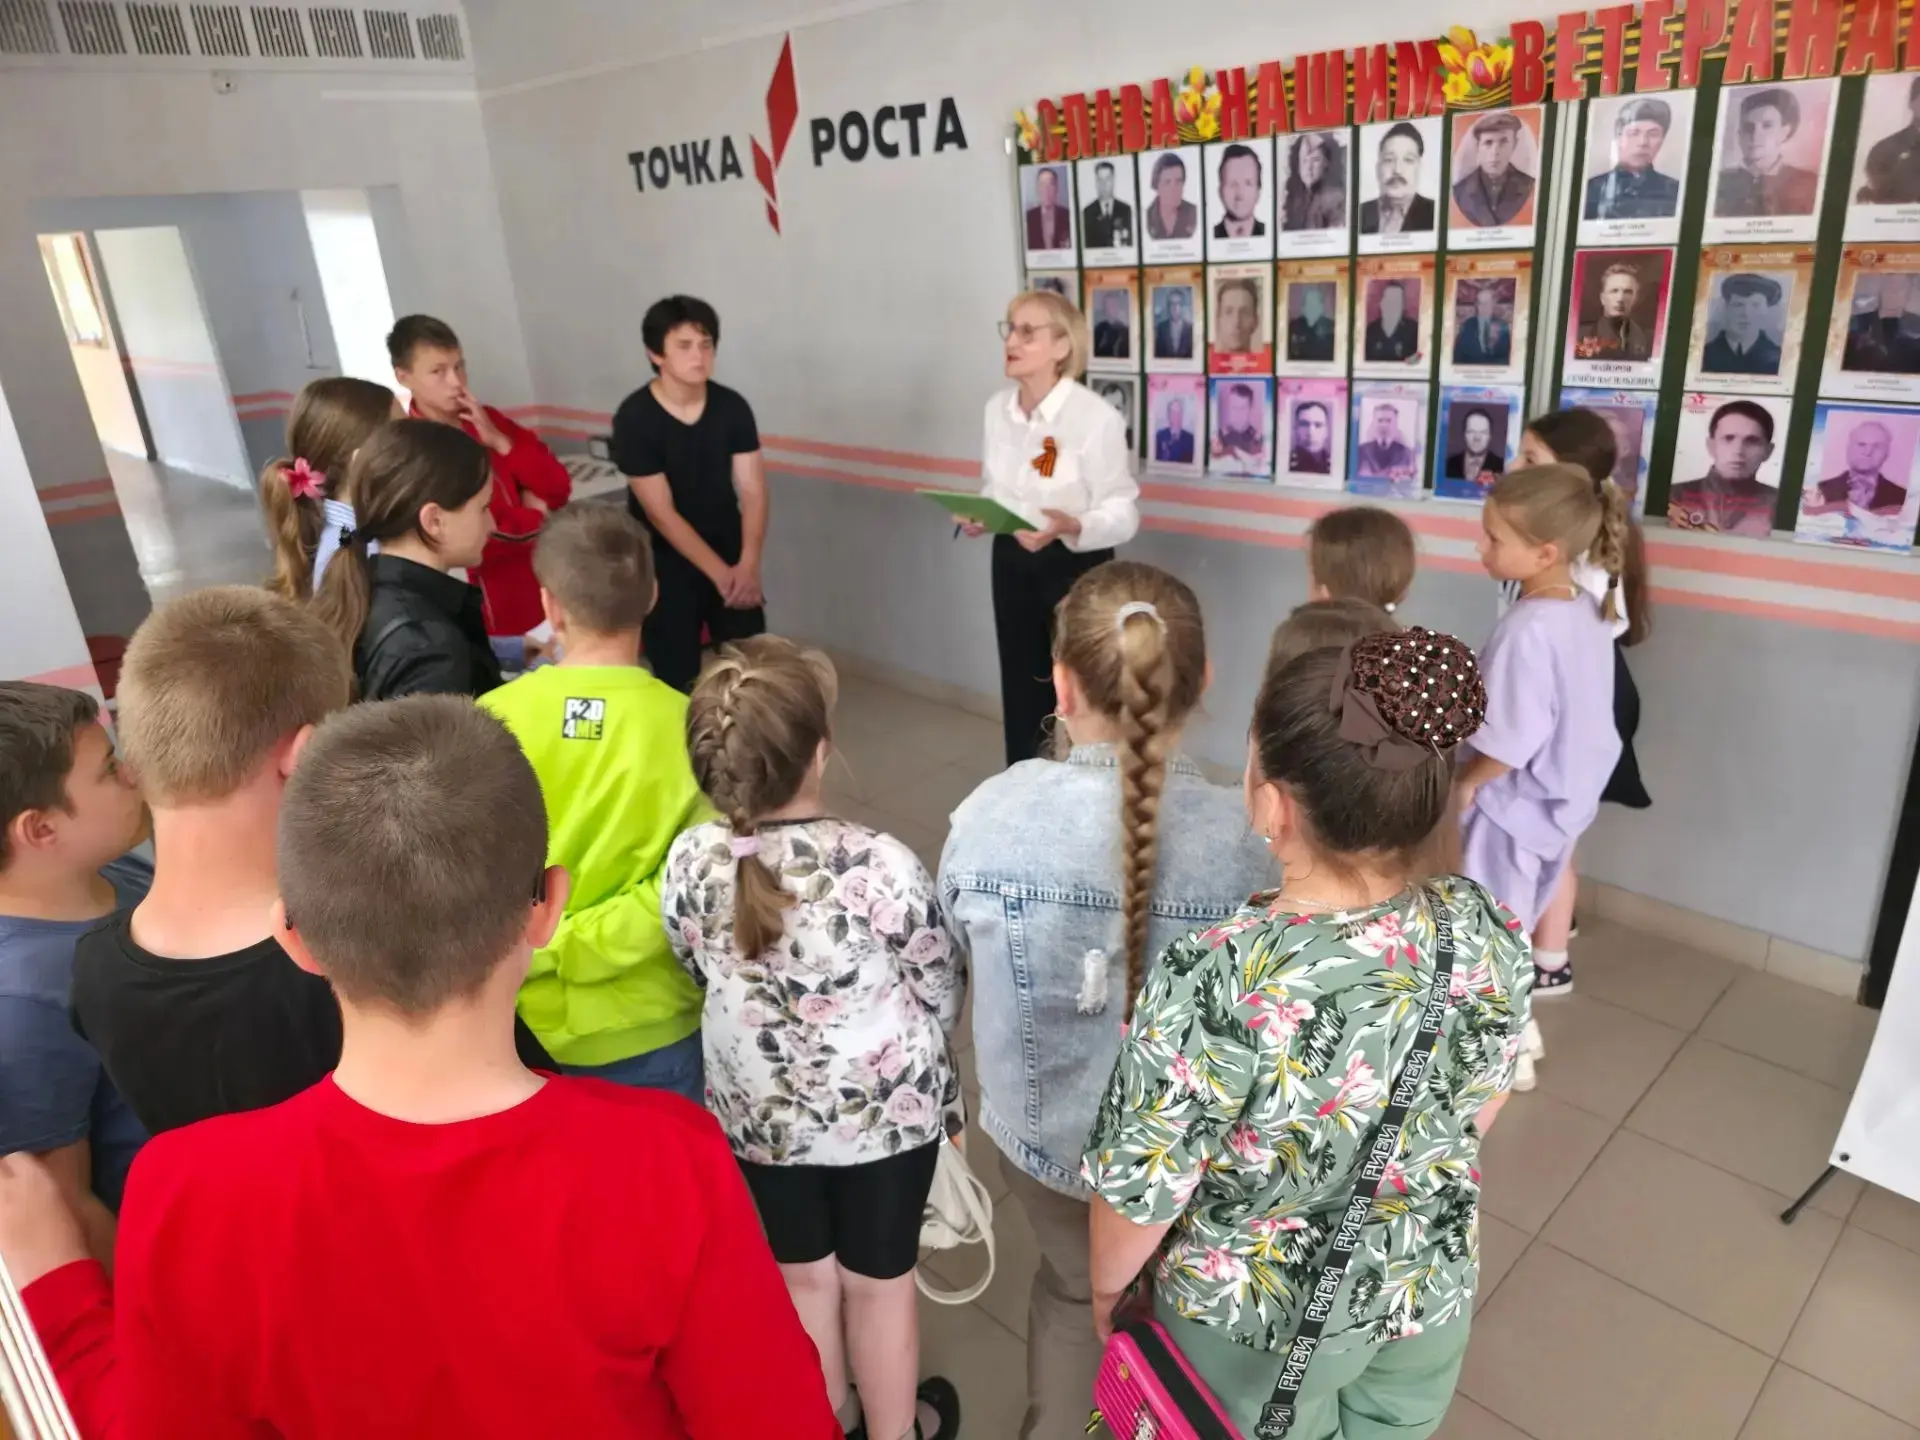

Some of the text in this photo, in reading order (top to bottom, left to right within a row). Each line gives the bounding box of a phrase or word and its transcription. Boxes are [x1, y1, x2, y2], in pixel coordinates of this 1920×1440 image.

[628, 96, 968, 193] ТОЧКА РОСТА
[1037, 0, 1920, 162] СЛАВА НАШИМ ВЕТЕРАНА
